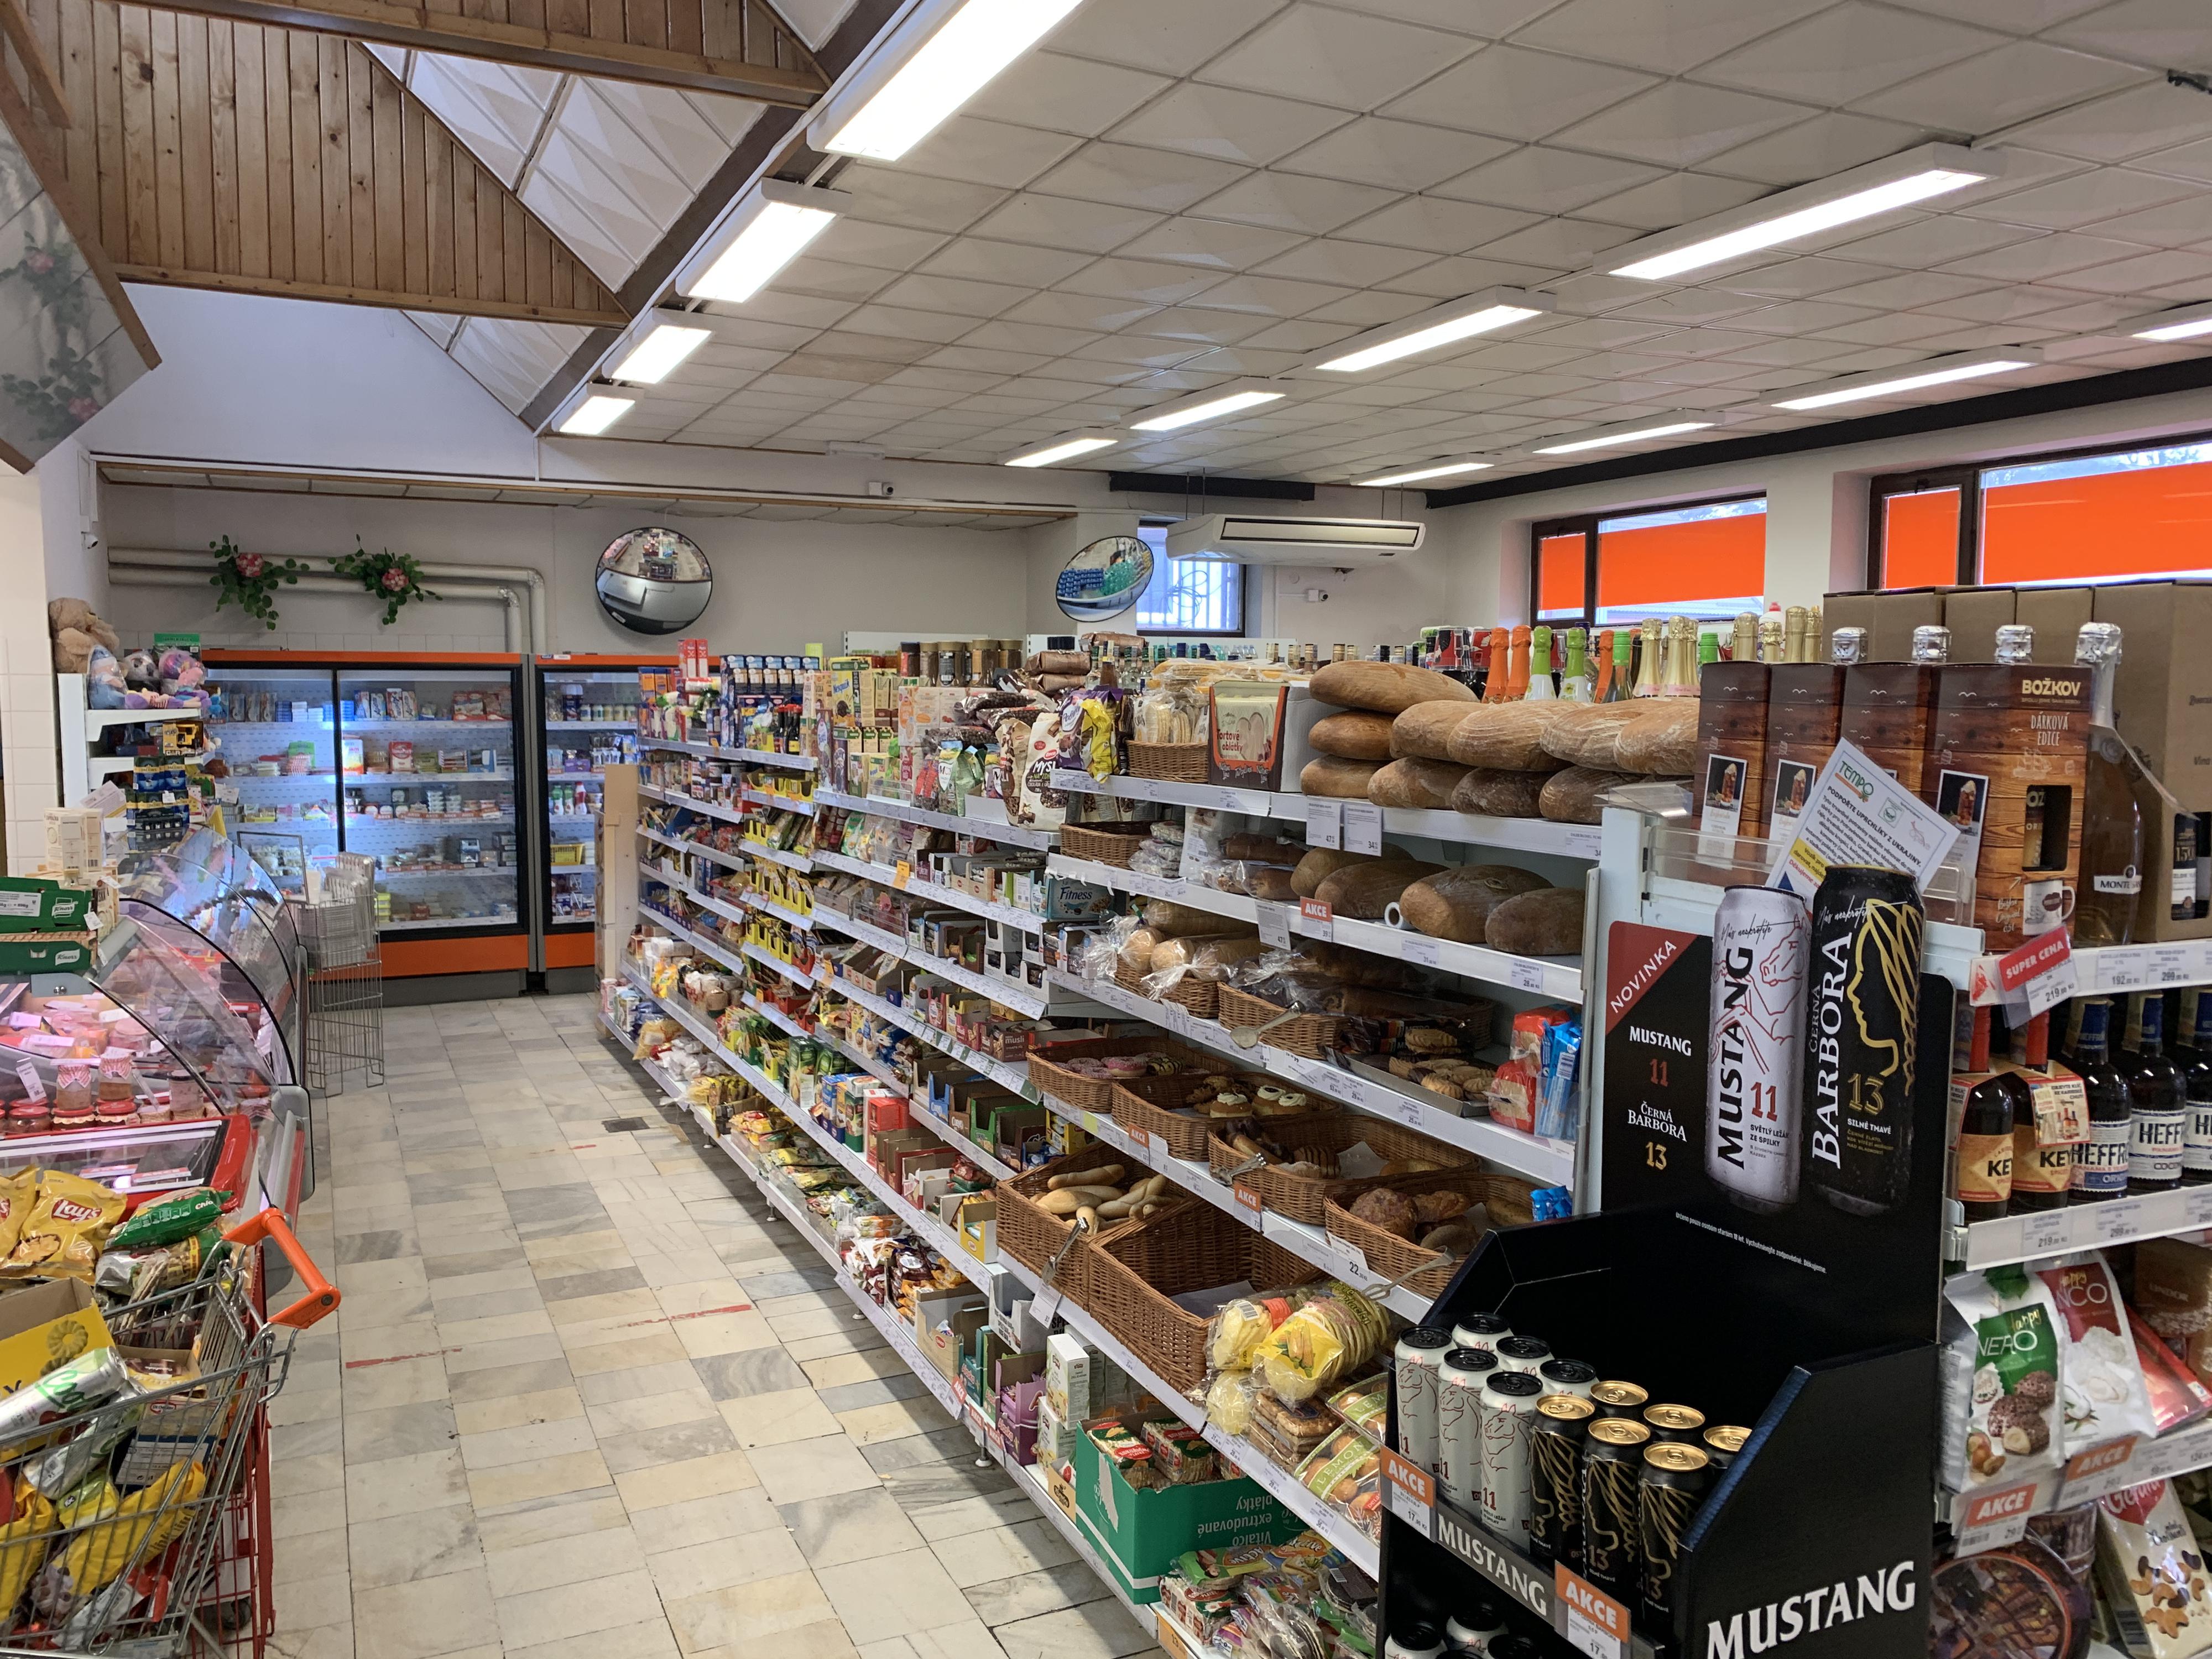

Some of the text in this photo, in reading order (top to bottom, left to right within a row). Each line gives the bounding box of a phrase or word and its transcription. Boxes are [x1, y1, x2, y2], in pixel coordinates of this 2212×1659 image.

[2022, 677, 2081, 696] BOŽKOV
[2031, 711, 2070, 730] DÁRKOVÁ
[2037, 731, 2060, 746] EDICE
[1840, 760, 1874, 796] TEMPO
[1827, 786, 1858, 812] PODPOŘTE
[1855, 810, 1888, 837] UPRCHLÍKY
[1891, 840, 1922, 866] UKRAJINY.
[1787, 859, 1815, 883] Děkujeme
[1060, 886, 1093, 900] Fitness
[1305, 902, 1327, 918] AKCE
[2006, 941, 2064, 979] SUPER CENA
[1610, 941, 1677, 1013] NOVINKA
[1005, 1035, 1025, 1044] musli
[1629, 1026, 1691, 1056] MUSTANG
[1812, 932, 1852, 1170] BARBORA
[1718, 947, 1754, 1170] MUSTANG
[1649, 1058, 1668, 1087] 11
[1750, 1082, 1777, 1121] 11
[1848, 1072, 1884, 1116] 13
[1641, 1100, 1673, 1123] ČERNÁ
[1131, 1129, 1145, 1144] AKCE
[1627, 1109, 1687, 1142] BARBORA
[1750, 1124, 1790, 1138] SVĚTLÝ LEŽÁK
[1848, 1118, 1891, 1135] SILNÉ TMAVÉ
[1759, 1136, 1780, 1146] SPILKY
[1645, 1141, 1667, 1171] 13
[53, 1199, 103, 1222] Lay's
[195, 1200, 214, 1210] Chio
[1238, 1189, 1257, 1207] AKCE
[1349, 1261, 1359, 1276] 22
[1978, 1329, 2038, 1357] NERO
[1316, 1442, 1364, 1485] LEMON
[2077, 1446, 2126, 1474] AKCE
[1388, 1459, 1425, 1498] AKCE
[1236, 1495, 1272, 1510] plátky
[1483, 1488, 1496, 1511] 11
[1977, 1491, 2027, 1520] AKCE
[1197, 1513, 1272, 1538] extrudované
[1233, 1531, 1272, 1546] Vitalco
[1438, 1514, 1547, 1616] MUSTANG
[1589, 1545, 1610, 1571] 13
[1566, 1580, 1617, 1630] AKCE
[1707, 1561, 1916, 1659] MUSTANG
